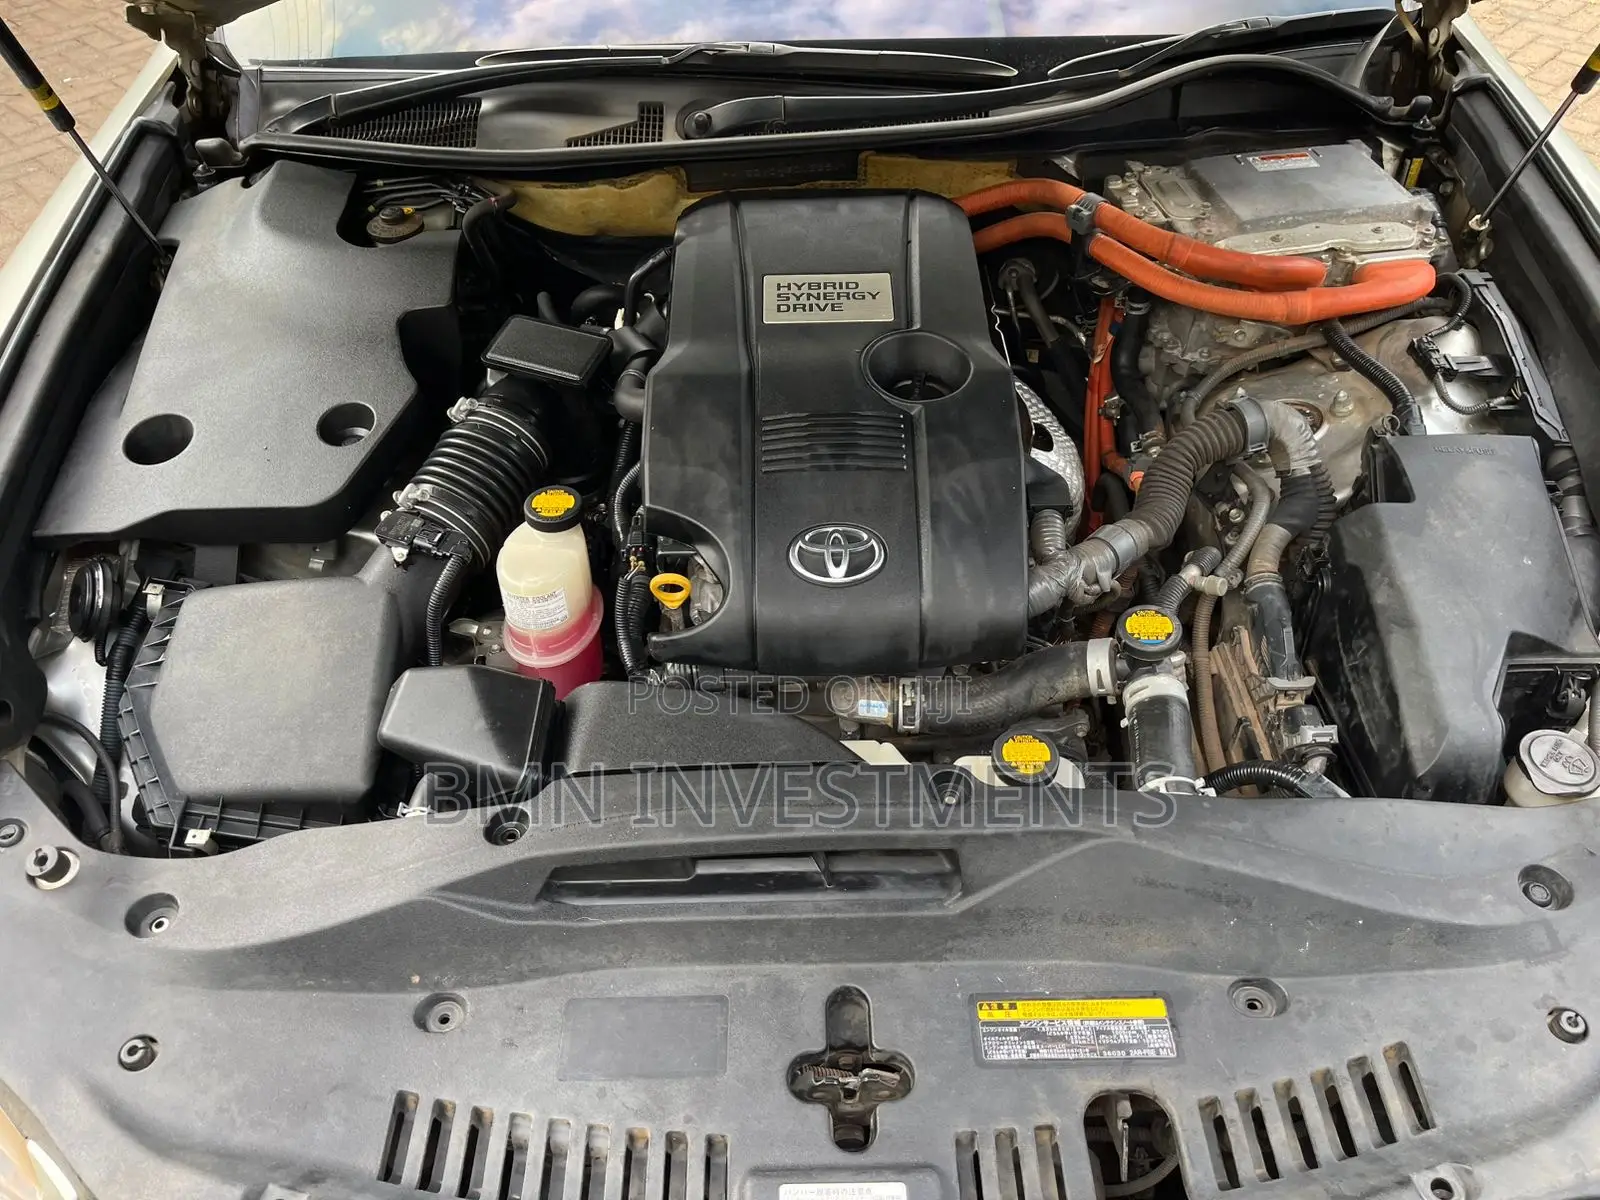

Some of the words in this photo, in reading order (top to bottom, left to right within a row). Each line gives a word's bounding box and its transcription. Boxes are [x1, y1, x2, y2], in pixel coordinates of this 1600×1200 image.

[776, 281, 860, 291] HYBRID
[776, 291, 880, 302] SYNERGY
[776, 302, 844, 313] DRIVE
